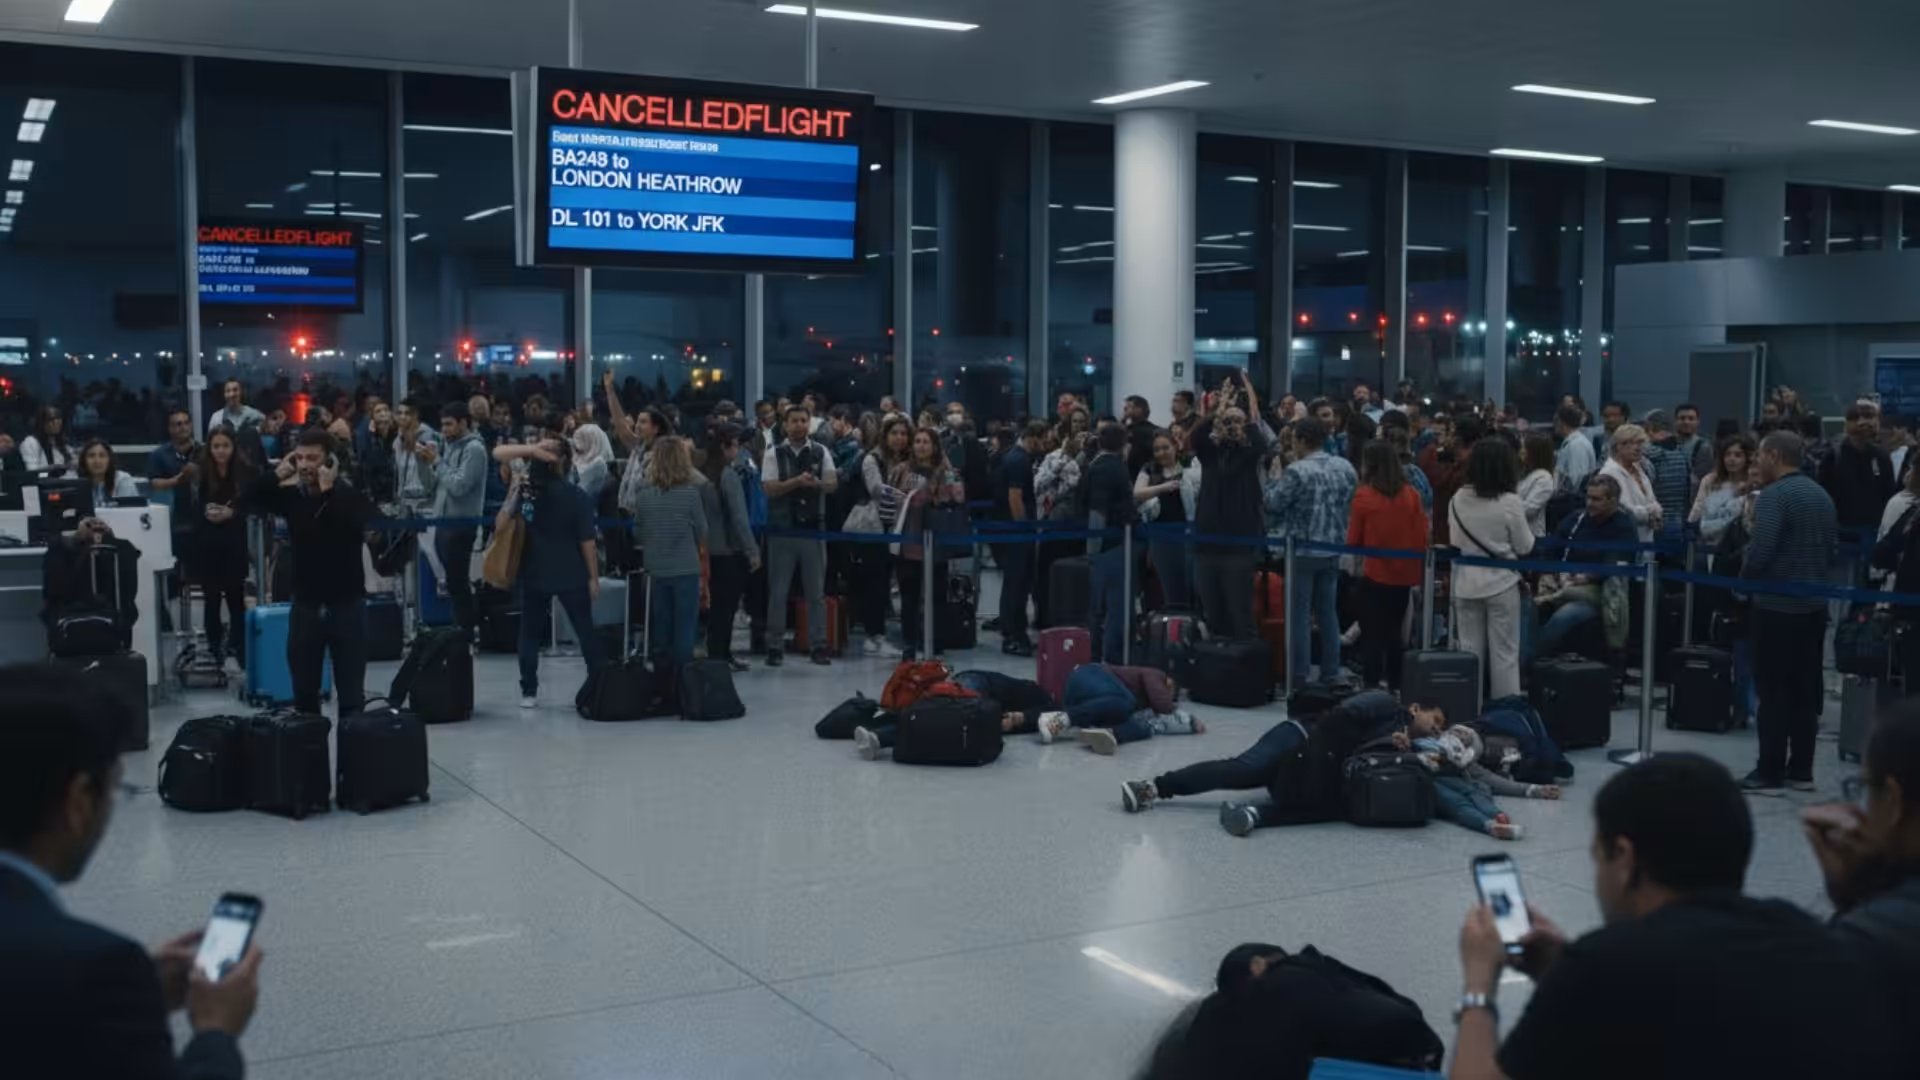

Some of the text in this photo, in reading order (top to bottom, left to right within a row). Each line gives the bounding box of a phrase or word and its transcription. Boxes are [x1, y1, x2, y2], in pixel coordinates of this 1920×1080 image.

[552, 89, 851, 137] CANCELLEDFLIGHT
[552, 149, 629, 169] BA248 to
[552, 168, 742, 194] LONDON HEATHROW
[552, 208, 725, 232] DL 101 to YORK JFK
[198, 226, 353, 245] CANCELLEDFLIGHT
